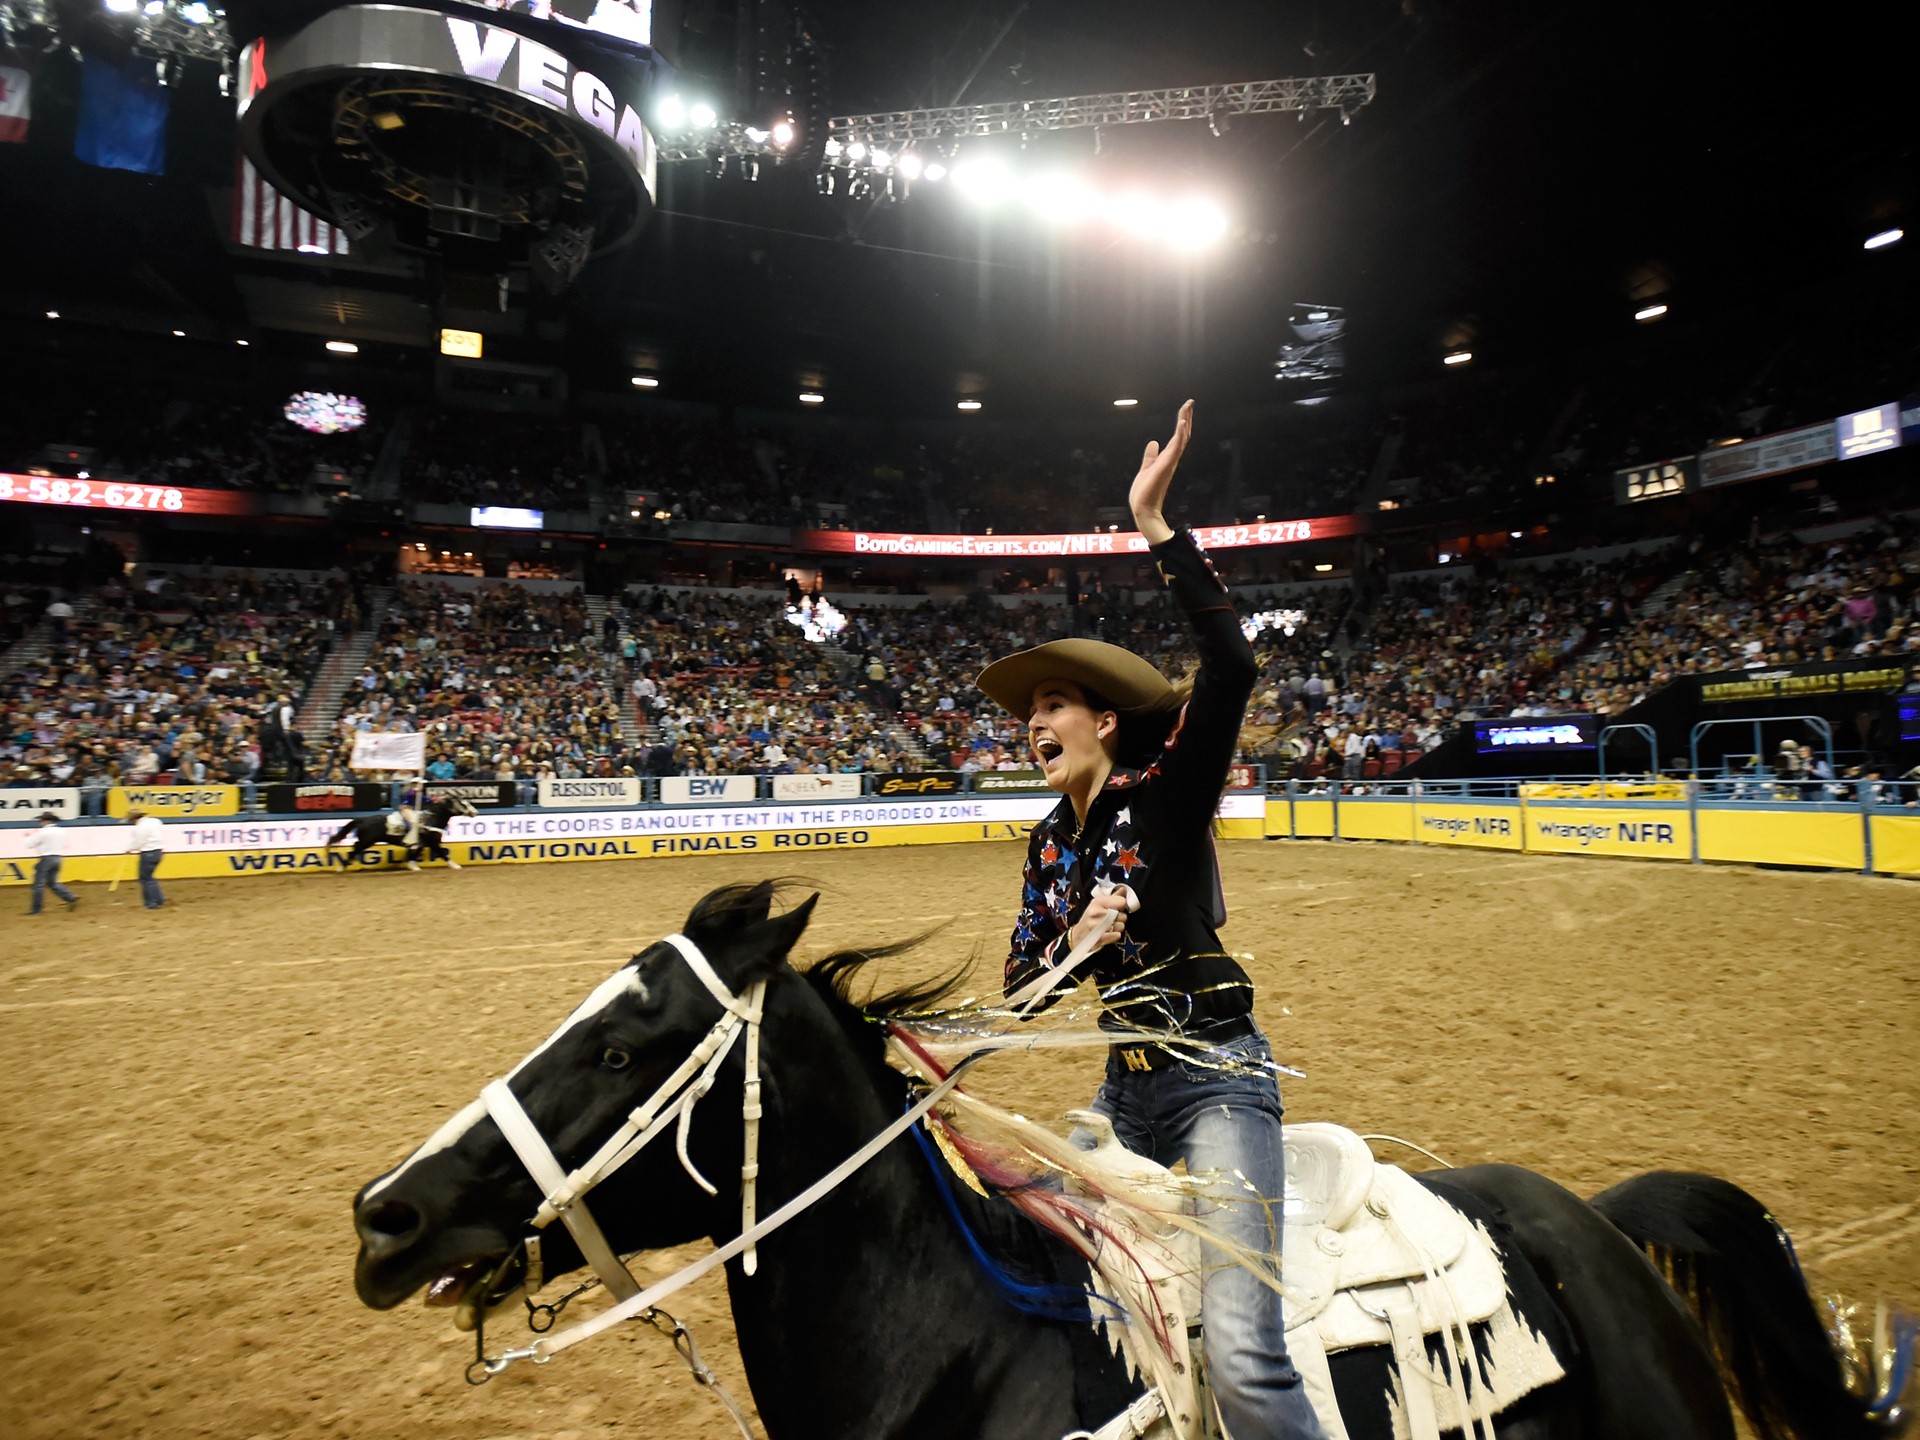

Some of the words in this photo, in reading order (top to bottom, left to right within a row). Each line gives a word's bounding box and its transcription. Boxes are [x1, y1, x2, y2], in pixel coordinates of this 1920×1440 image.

[124, 790, 225, 813] Wrangler
[551, 782, 626, 797] RESISTOL
[185, 827, 309, 845] THIRSTY?
[459, 822, 486, 836] TO
[495, 821, 536, 834] THE
[544, 817, 614, 833] COORS
[620, 814, 715, 831] BANQUET
[720, 812, 770, 825] TENT
[777, 811, 794, 824] IN
[801, 810, 835, 823] THE
[840, 806, 934, 822] PRORODEO
[940, 804, 987, 817] ZONE.
[1421, 815, 1471, 837] Wrangler
[1474, 817, 1511, 836] NFR
[1537, 821, 1612, 846] Wrangler
[1618, 823, 1674, 844] NFR
[229, 848, 450, 871] WRANGLR
[470, 841, 638, 861] NATIONAL
[653, 834, 757, 853] FINALS
[774, 829, 870, 848] RODEO
